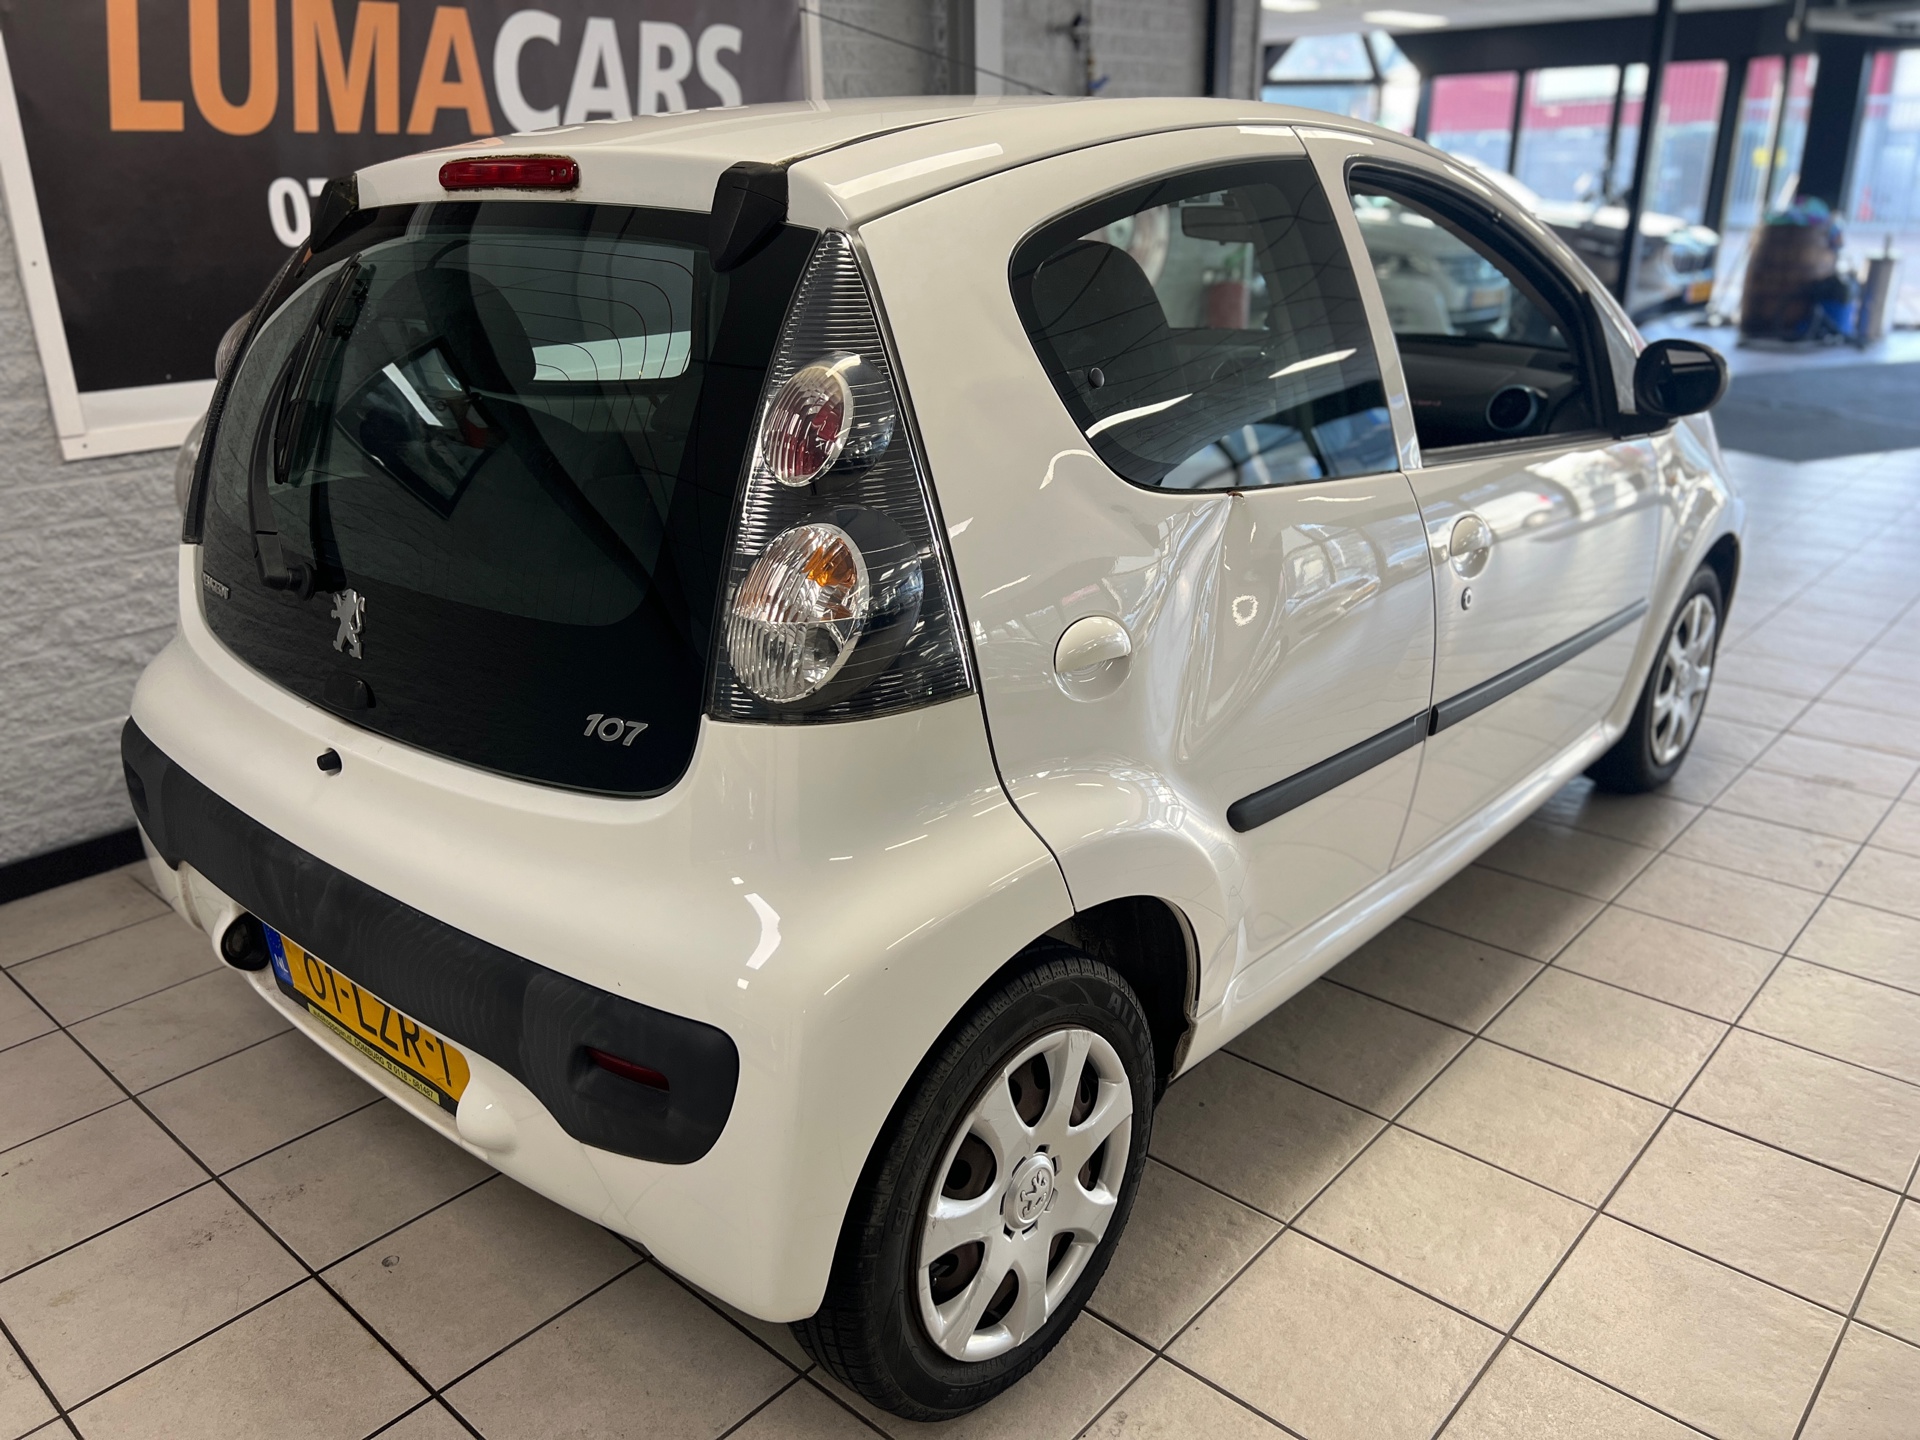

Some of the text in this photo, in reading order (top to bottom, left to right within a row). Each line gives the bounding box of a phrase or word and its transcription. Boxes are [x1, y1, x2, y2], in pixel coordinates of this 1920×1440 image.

[107, 0, 742, 134] LUMACARS
[583, 713, 649, 747] 107
[273, 953, 289, 973] NL
[303, 951, 452, 1087] 01-LZR-1
